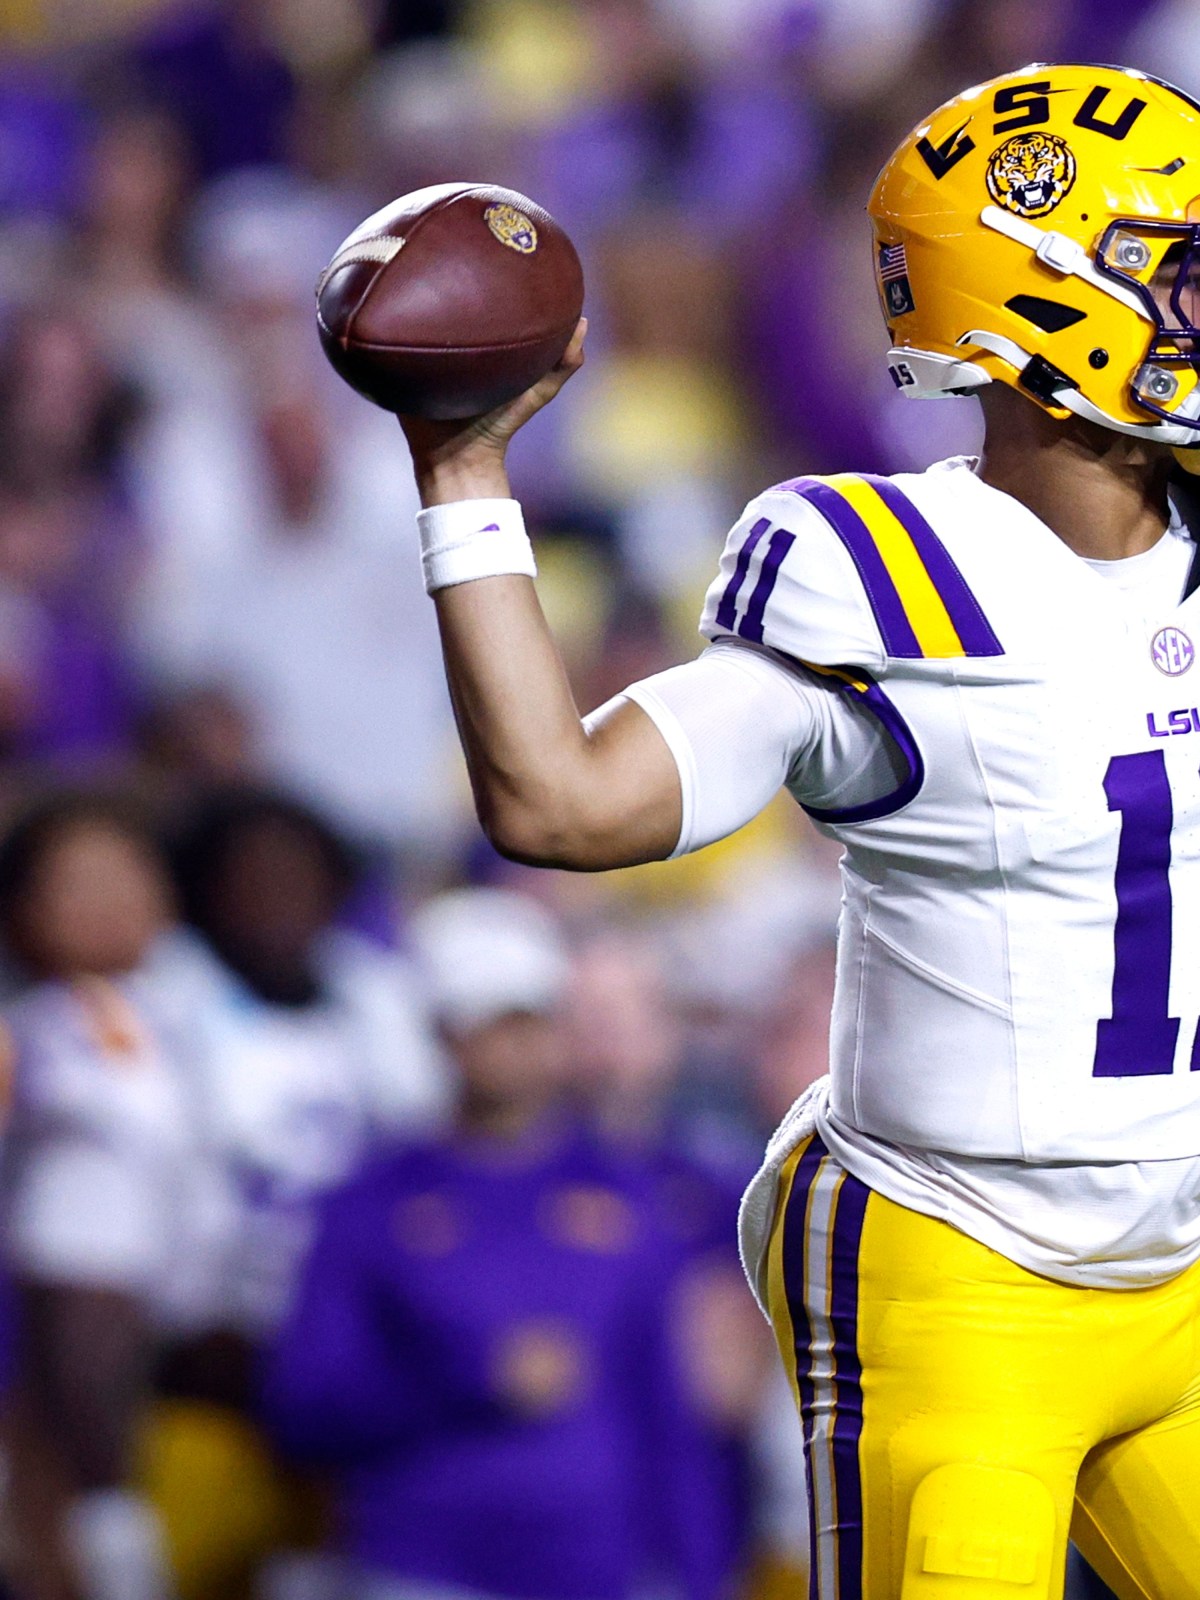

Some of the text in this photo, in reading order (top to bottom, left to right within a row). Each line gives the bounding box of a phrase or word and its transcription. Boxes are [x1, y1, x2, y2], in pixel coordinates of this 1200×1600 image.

[916, 81, 1147, 180] LSU
[716, 517, 796, 644] 11
[1152, 628, 1194, 674] SEC
